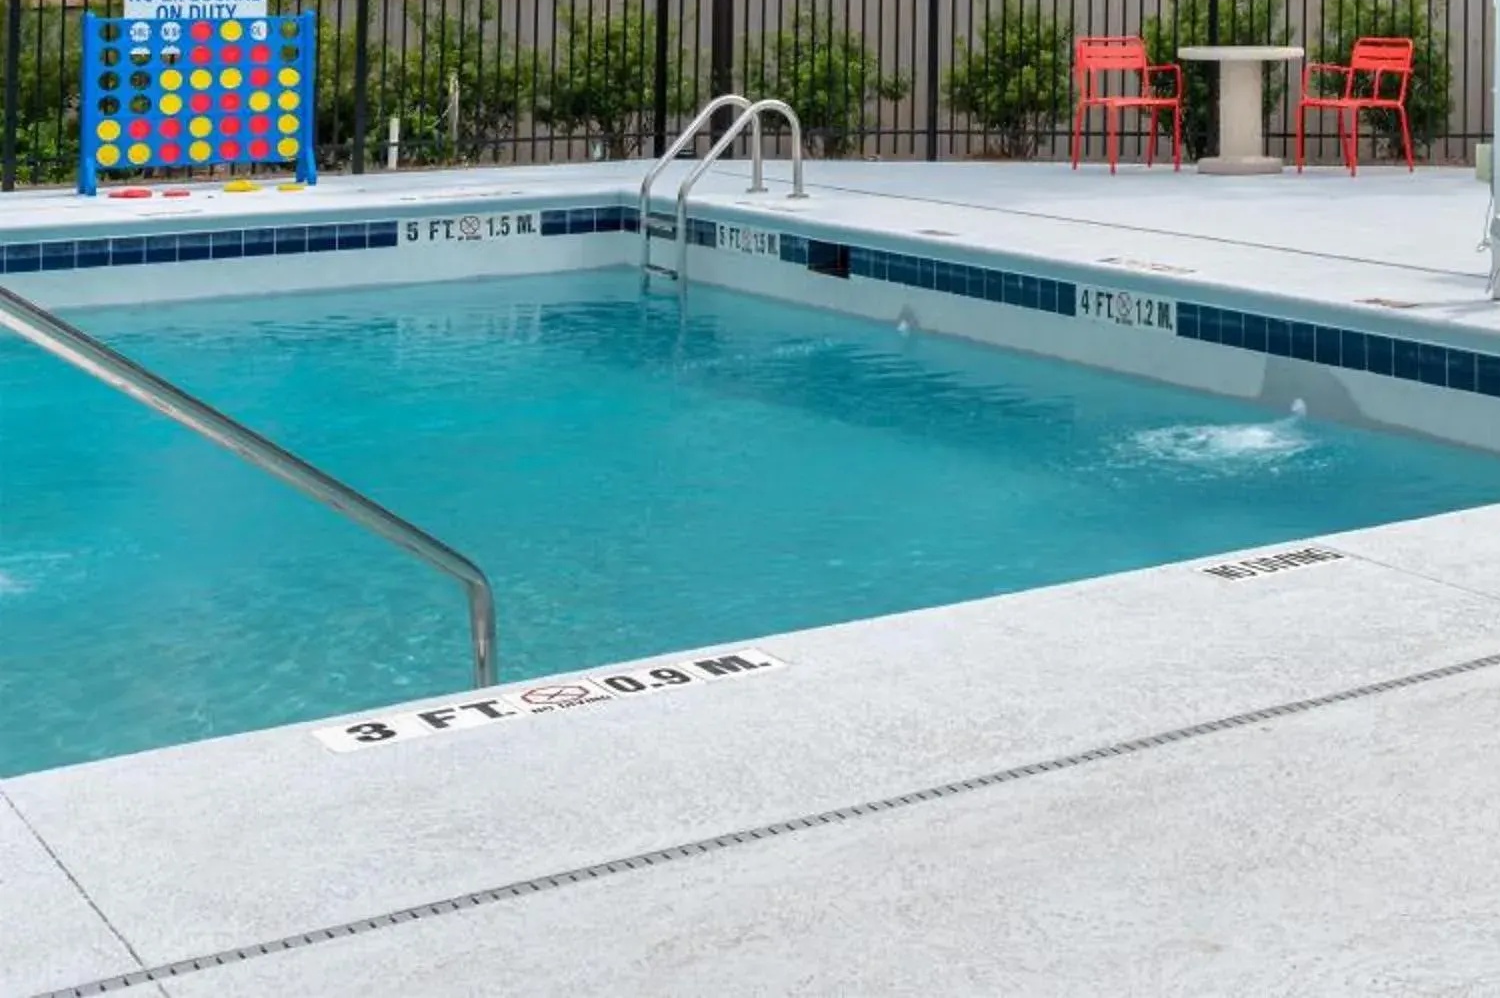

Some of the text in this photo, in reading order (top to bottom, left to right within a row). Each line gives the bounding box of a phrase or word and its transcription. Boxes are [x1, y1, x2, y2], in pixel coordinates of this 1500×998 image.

[156, 4, 237, 18] ON DUTY
[407, 221, 418, 241] 5
[487, 215, 510, 237] 1.5
[1082, 289, 1089, 314] 4
[346, 654, 772, 742] 3 FT. 0.9 M.
